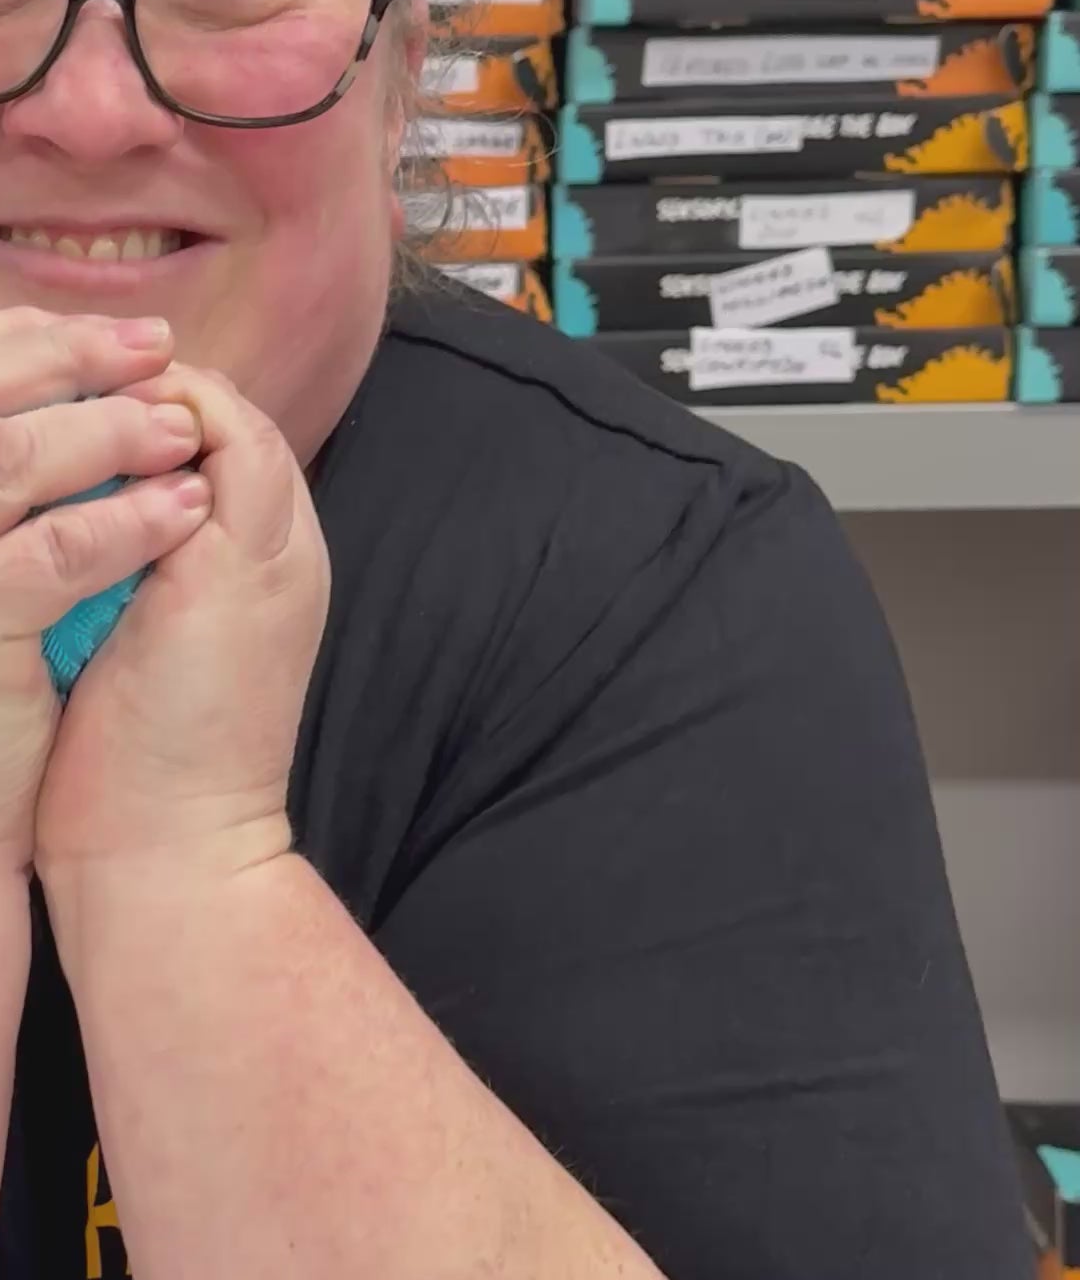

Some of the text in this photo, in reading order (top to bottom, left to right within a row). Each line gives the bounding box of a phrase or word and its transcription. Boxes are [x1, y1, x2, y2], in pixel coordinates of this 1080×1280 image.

[875, 112, 917, 138] BOX
[865, 269, 908, 294] BOX
[866, 344, 909, 370] BOX
